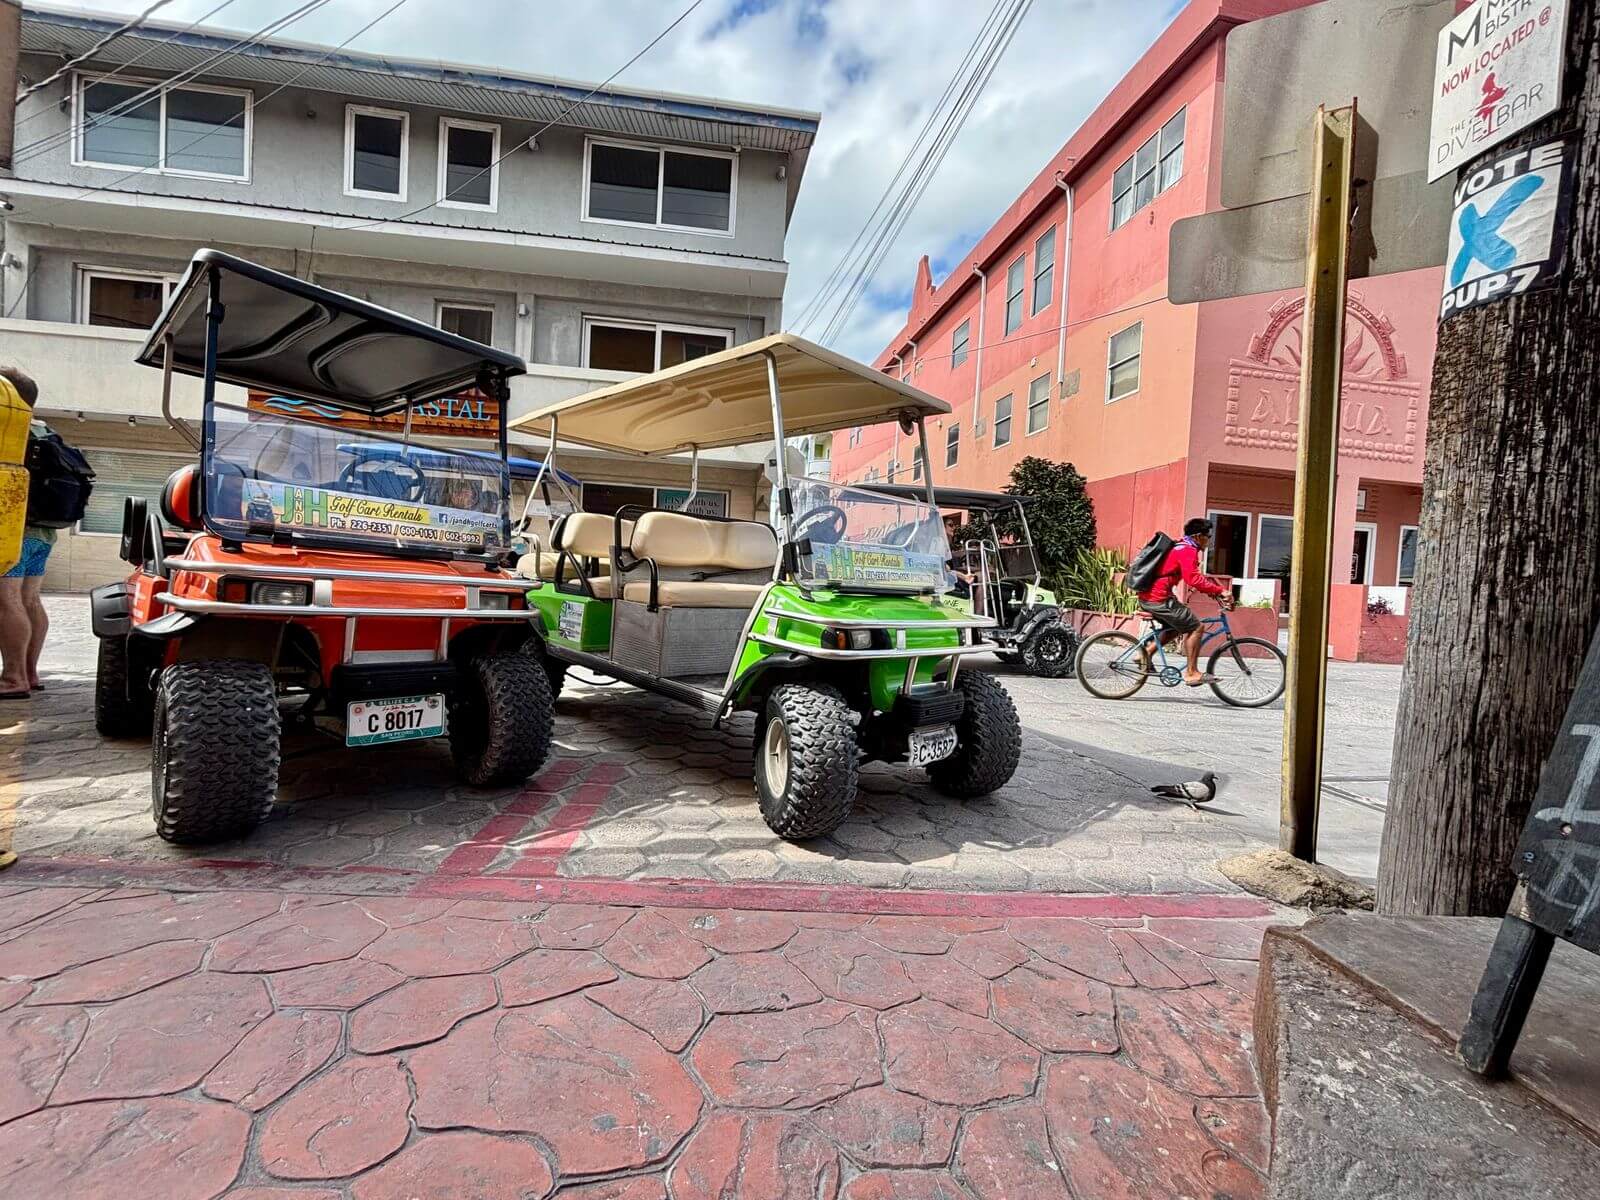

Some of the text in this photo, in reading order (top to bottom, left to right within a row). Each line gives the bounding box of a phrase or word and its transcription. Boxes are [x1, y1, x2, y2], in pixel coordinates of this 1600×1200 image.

[1441, 63, 1472, 97] NOW
[1474, 20, 1535, 74] LOCATED
[1539, 6, 1552, 26] @
[1437, 82, 1544, 164] DIVE BAR
[1450, 119, 1466, 135] THE
[1454, 140, 1565, 208] VOTE
[1441, 265, 1541, 319] PUP7
[395, 398, 492, 421] ASTAL
[281, 486, 294, 524] J
[304, 489, 328, 527] H
[330, 496, 423, 521] Golf Cart Rentals
[330, 516, 346, 528] Ph:
[351, 519, 392, 534] 226-2351
[400, 525, 438, 539] 600-1151
[445, 530, 480, 544] 602-9992
[367, 709, 424, 733] C 8017
